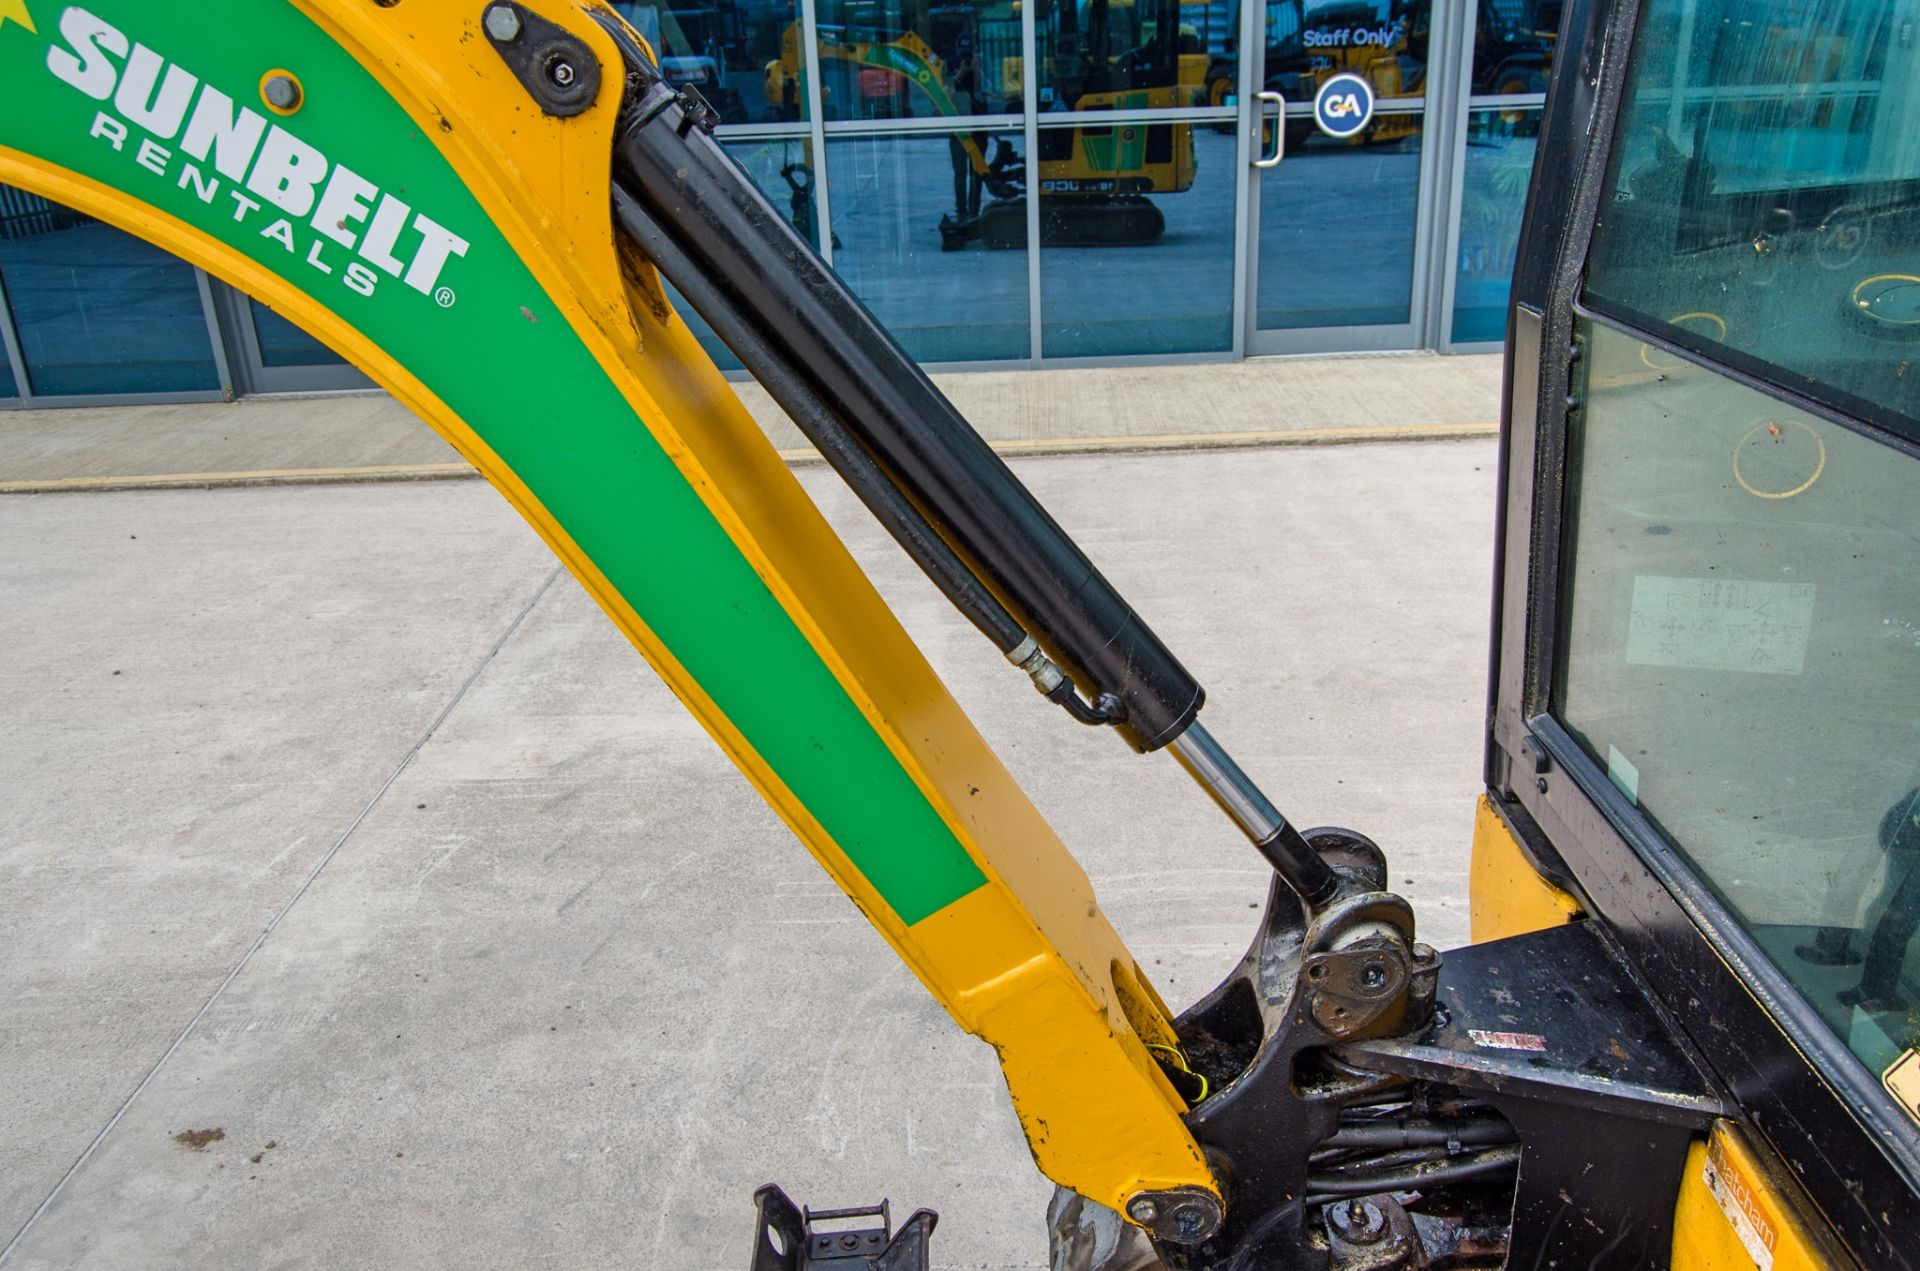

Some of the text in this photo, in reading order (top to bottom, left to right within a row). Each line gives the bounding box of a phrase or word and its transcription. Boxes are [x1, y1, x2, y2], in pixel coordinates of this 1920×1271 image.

[1303, 27, 1395, 49] Staff Only
[46, 6, 470, 296] SUNBELT
[1324, 93, 1362, 118] GA
[90, 111, 378, 298] RENTALS
